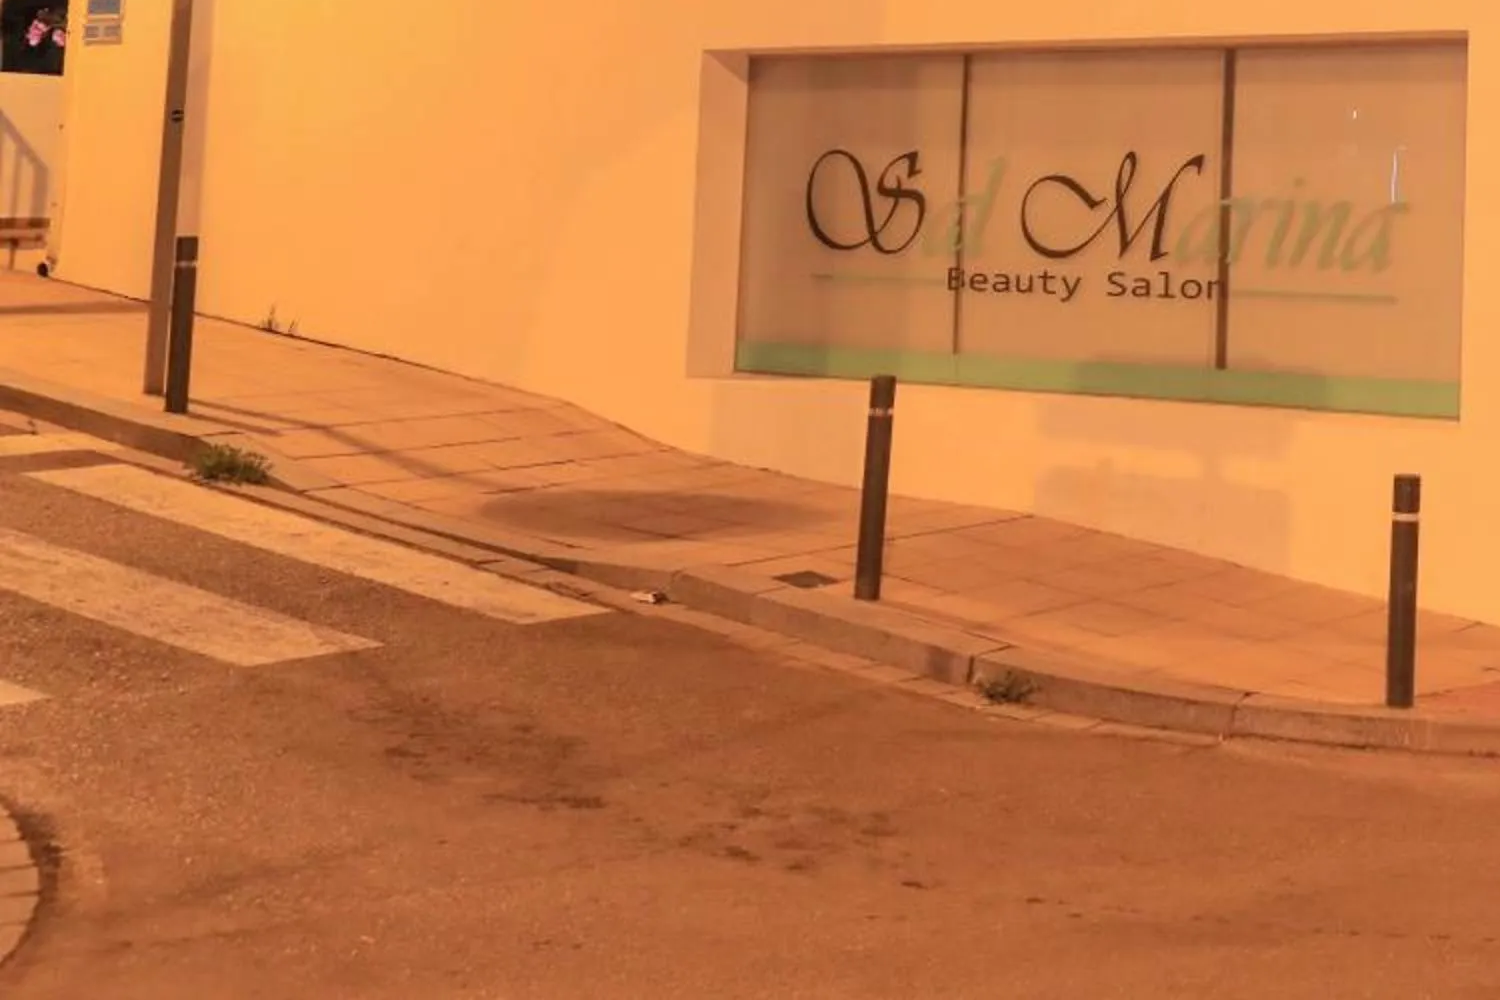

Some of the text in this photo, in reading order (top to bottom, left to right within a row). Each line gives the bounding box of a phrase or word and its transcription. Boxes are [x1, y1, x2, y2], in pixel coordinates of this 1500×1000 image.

[1021, 150, 1411, 273] Marina
[946, 267, 1226, 302] Beauty Salon
